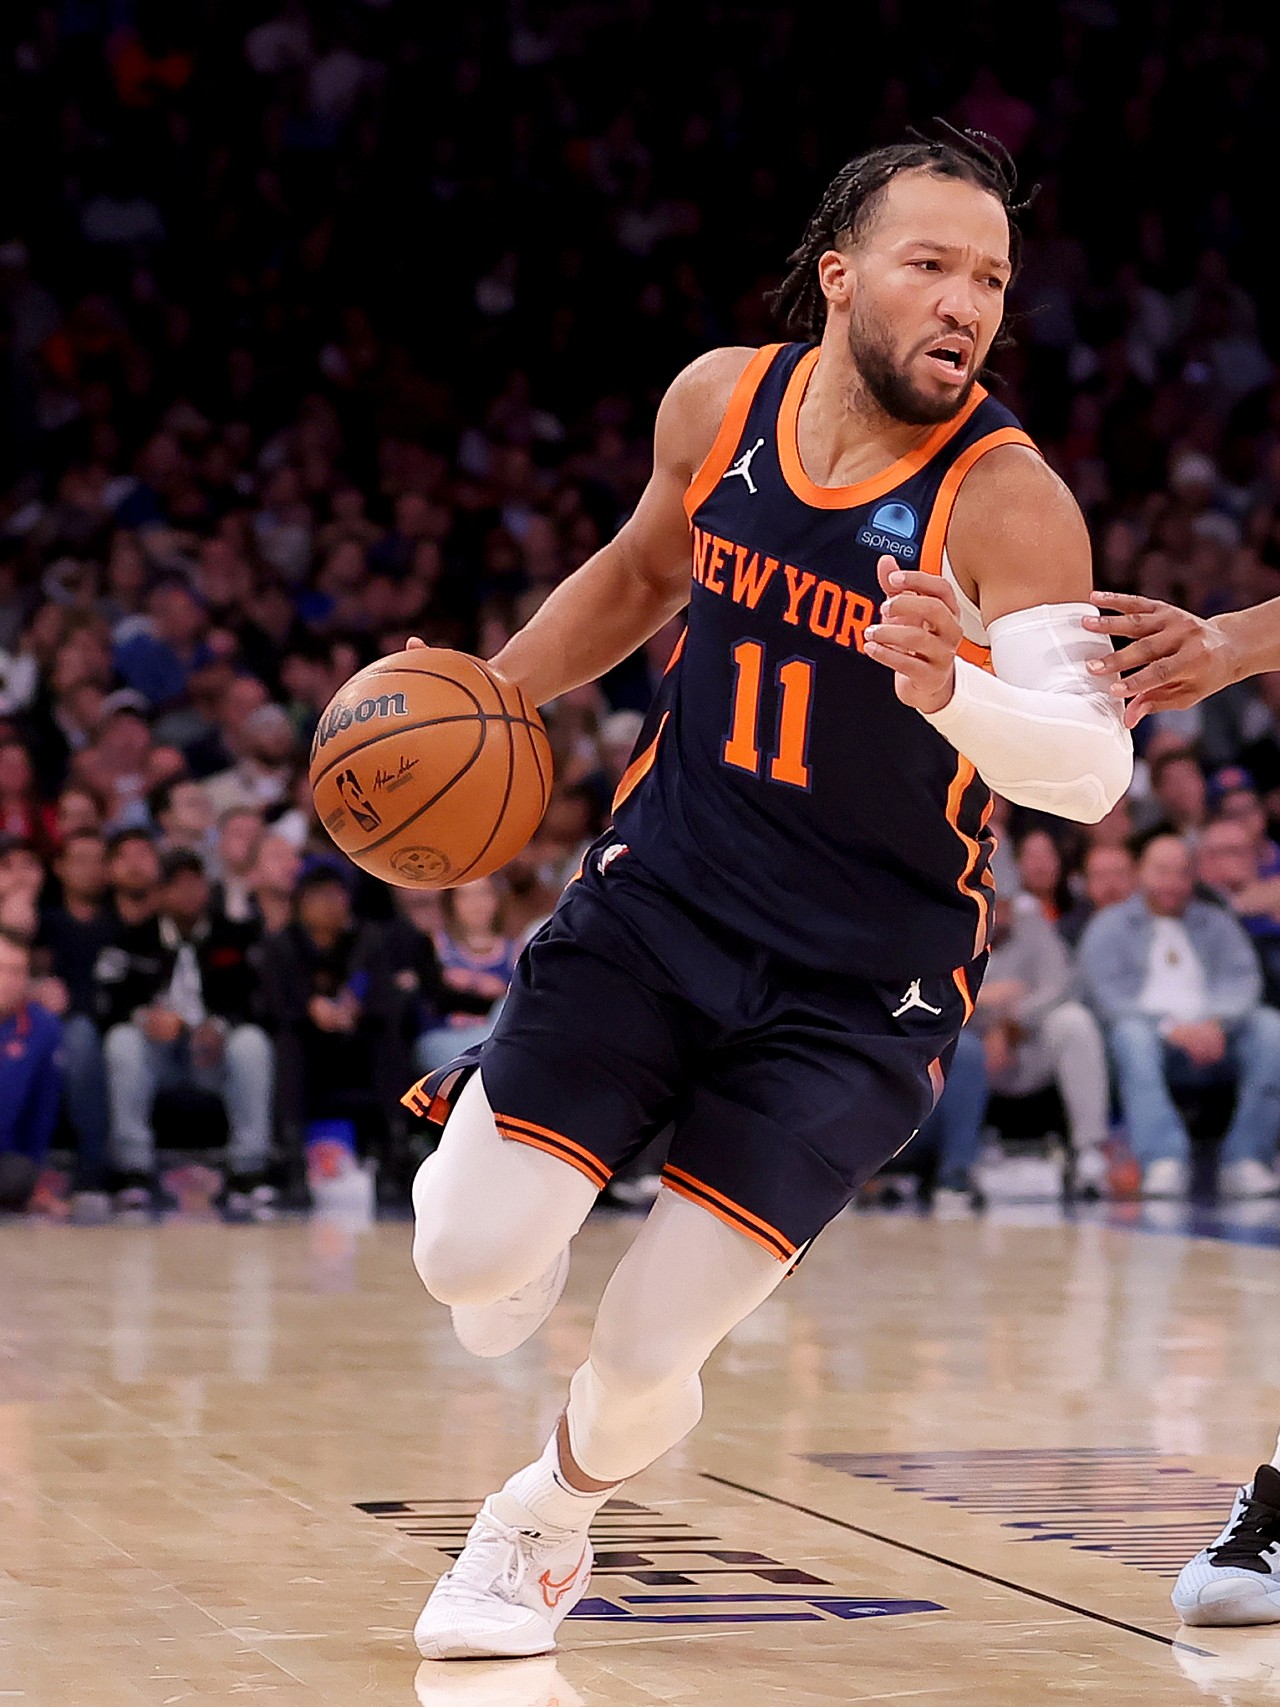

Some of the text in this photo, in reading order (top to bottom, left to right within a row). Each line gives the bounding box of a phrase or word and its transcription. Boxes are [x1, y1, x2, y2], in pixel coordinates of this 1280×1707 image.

[692, 525, 881, 655] NEW YOR
[861, 531, 914, 558] sphere
[721, 639, 815, 790] 11
